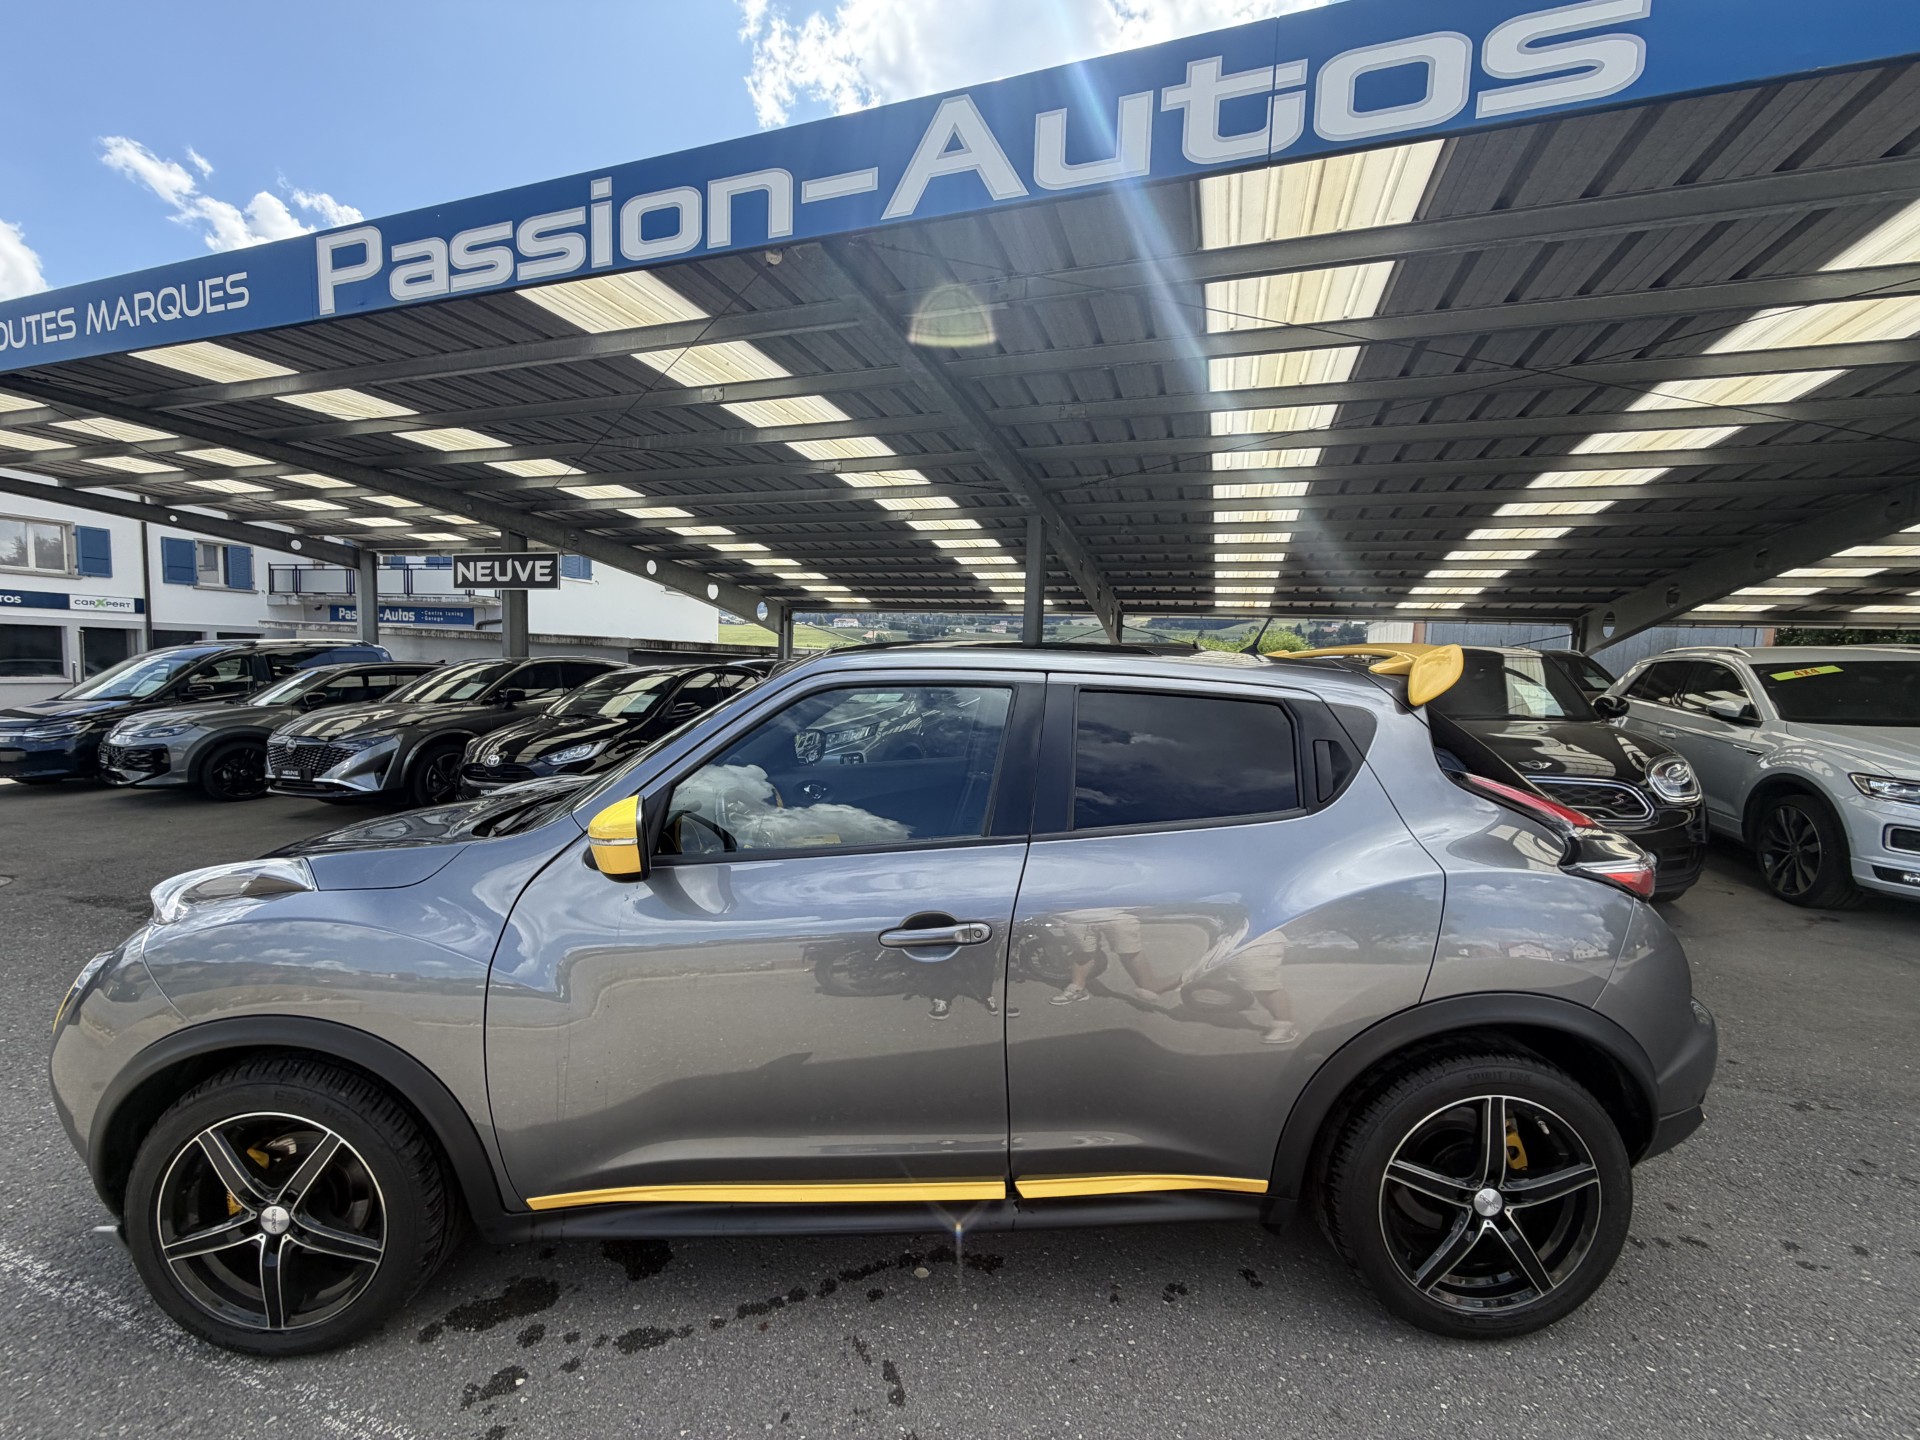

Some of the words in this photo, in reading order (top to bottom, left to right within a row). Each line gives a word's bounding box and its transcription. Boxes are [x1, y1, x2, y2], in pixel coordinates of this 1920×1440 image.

[315, 0, 1652, 316] Passion-Autos
[86, 271, 249, 335] MARQUES
[457, 558, 553, 585] NEUVE
